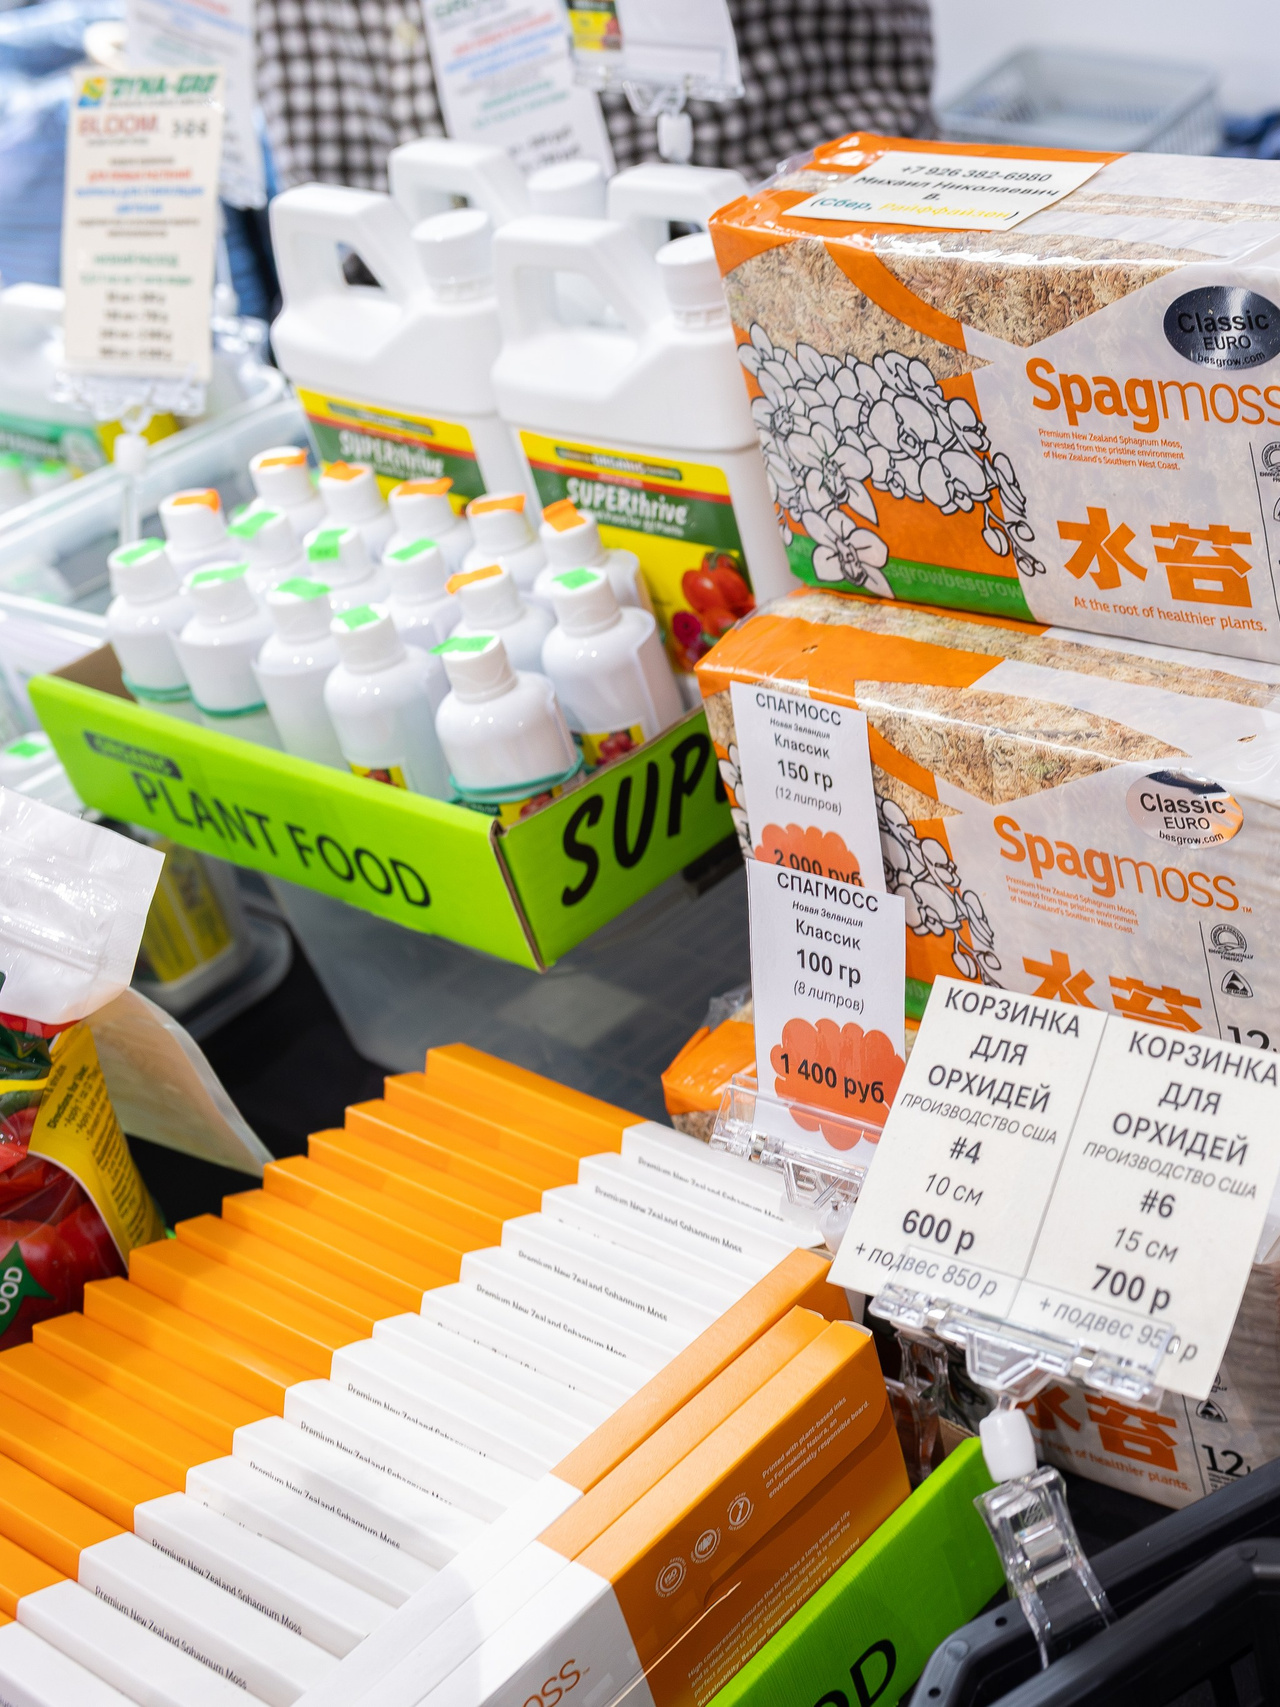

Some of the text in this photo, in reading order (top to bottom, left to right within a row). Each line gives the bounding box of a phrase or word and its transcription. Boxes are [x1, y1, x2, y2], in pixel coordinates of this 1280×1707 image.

[854, 176, 1060, 196] Михаил Николаевич
[902, 166, 1052, 182] +7 926 382-6980
[811, 198, 1019, 220] (Сбер, Райффайзен)
[923, 192, 940, 200] В.
[1178, 309, 1269, 335] Classic
[1198, 351, 1265, 368] besgrow.com
[1203, 336, 1251, 351] EURO
[1038, 428, 1182, 449] Premium New Zealand Sphagnum Moss,
[1040, 439, 1184, 459] harvested from the pristine environment
[1043, 450, 1180, 470] of New Zealand's Southern West Coast.
[566, 477, 687, 525] SUPERthrive
[1057, 506, 1252, 608] 水苔
[1074, 595, 1266, 631] At the root of healthier plants.
[756, 693, 841, 727] СПАГМОСС
[769, 717, 830, 738] Новая Зеландия
[774, 733, 830, 759] Классик
[777, 759, 832, 791] 150 гр
[775, 785, 841, 815] (12 литров)
[1140, 792, 1226, 815] Classic
[562, 733, 728, 907] SUP
[1164, 817, 1210, 831] EURO
[131, 772, 431, 907] PLANT FOOD
[1159, 830, 1224, 845] besgrow.com
[774, 849, 783, 866] 2
[790, 854, 823, 877] 000
[777, 872, 879, 912] СПАГМОСС
[792, 900, 862, 927] Новая Зеландия
[795, 919, 861, 950] Классик
[796, 949, 860, 987] 100 гр
[793, 979, 863, 1014] (8 литров)
[944, 987, 1080, 1038] КОРЗИНКА
[970, 1034, 1029, 1066] ДЛЯ
[1128, 1031, 1279, 1088] КОРЗИНКА
[780, 1053, 884, 1104] 1 400 руб
[928, 1065, 1051, 1114] ОРХИДЕЙ
[1158, 1081, 1223, 1116] ДЛЯ
[900, 1093, 1056, 1144] ПРОИЗВОДСТВО США
[950, 1136, 982, 1165] #4
[1112, 1111, 1249, 1167] ОРХИДЕЙ
[1083, 1141, 1256, 1198] ПРОИЗВОДСТВО США
[925, 1173, 984, 1207] 10 см
[1140, 1188, 1175, 1219] #6
[902, 1209, 975, 1255] 600 р
[1114, 1227, 1179, 1264] 15 см
[868, 1244, 939, 1280] подвес
[942, 1265, 981, 1291] 850
[979, 1277, 998, 1298] р
[1091, 1264, 1171, 1314] 700 р
[1054, 1301, 1134, 1340] подвес
[1179, 1341, 1198, 1363] р
